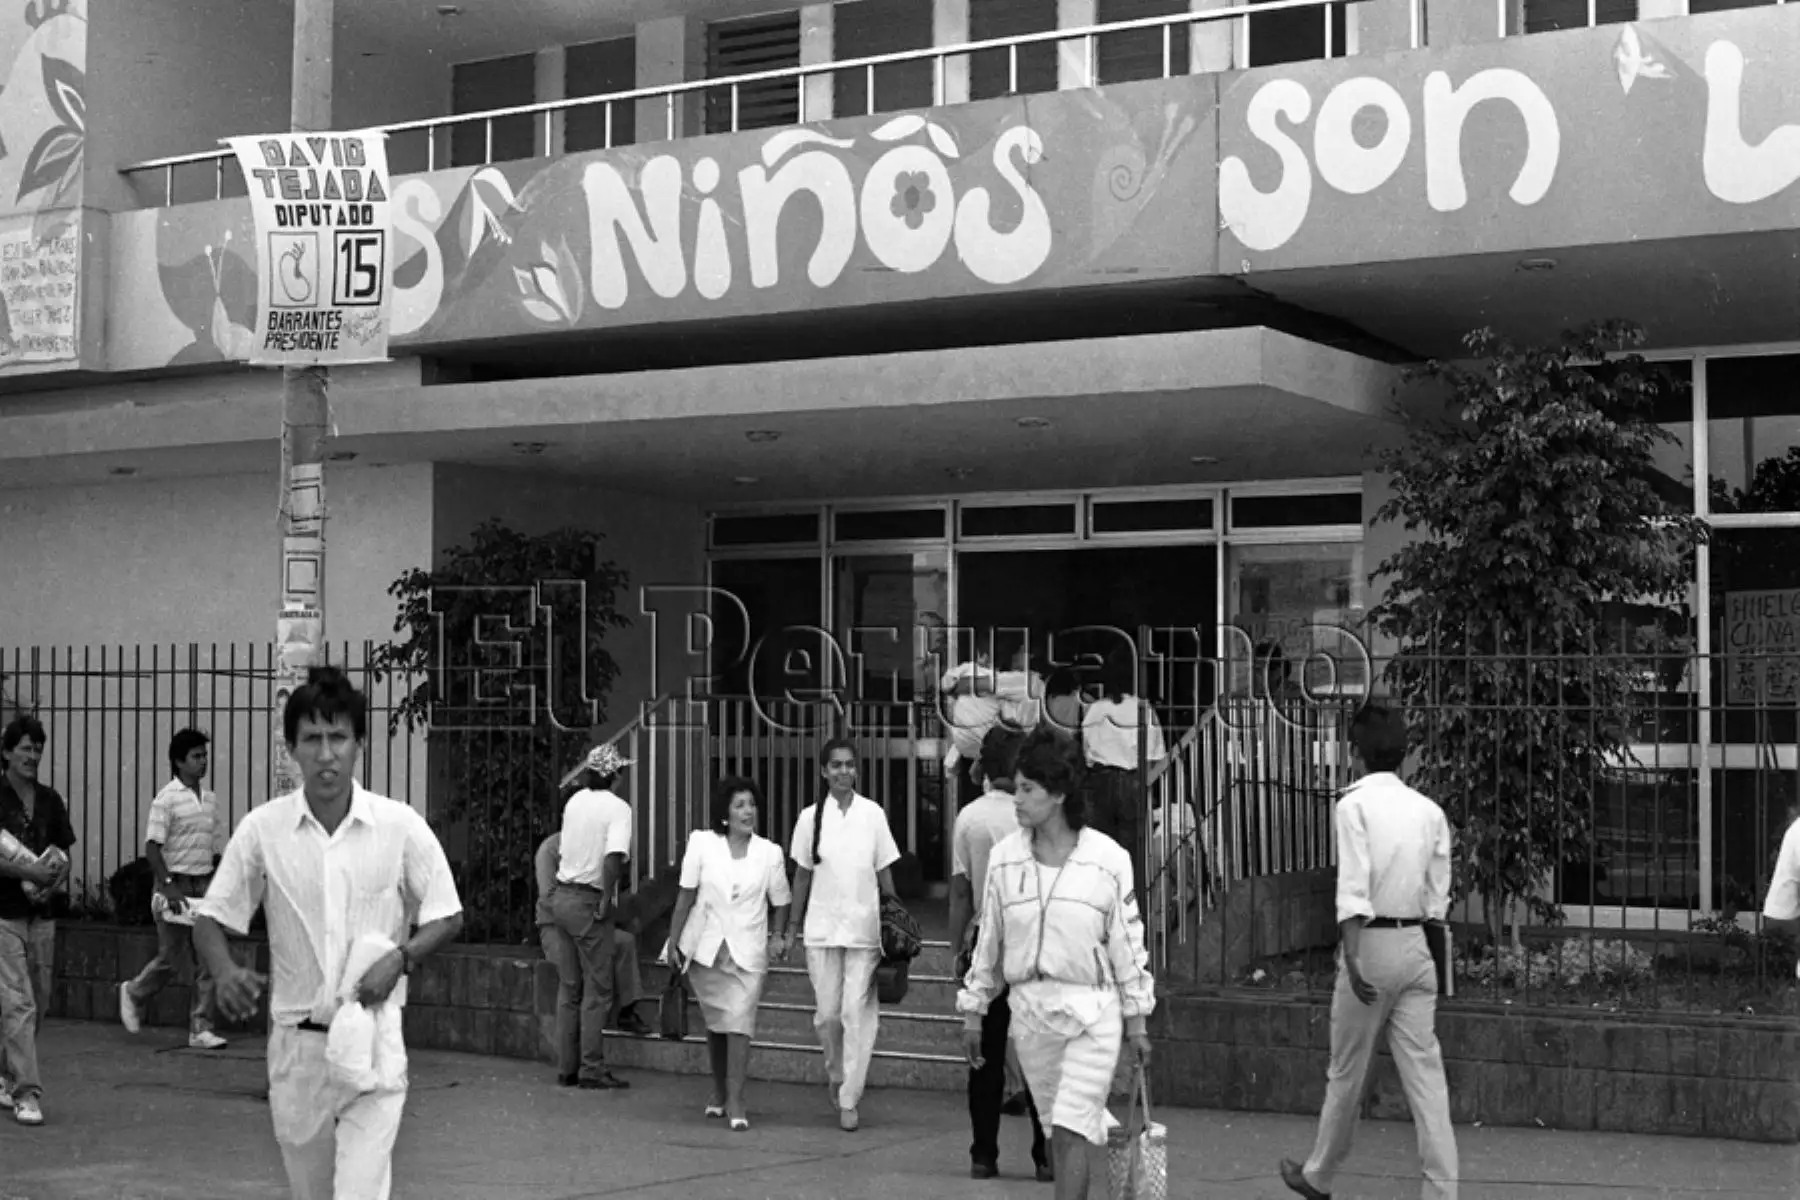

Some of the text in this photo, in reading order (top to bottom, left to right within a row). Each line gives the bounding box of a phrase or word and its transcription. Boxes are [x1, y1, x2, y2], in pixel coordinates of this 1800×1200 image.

[258, 136, 366, 168] DAVID
[252, 167, 387, 202] TEJADA
[274, 203, 374, 227] DIPUTADO
[340, 237, 378, 299] 15
[267, 309, 343, 332] BARRANTES
[263, 331, 340, 352] PRESIDENTE
